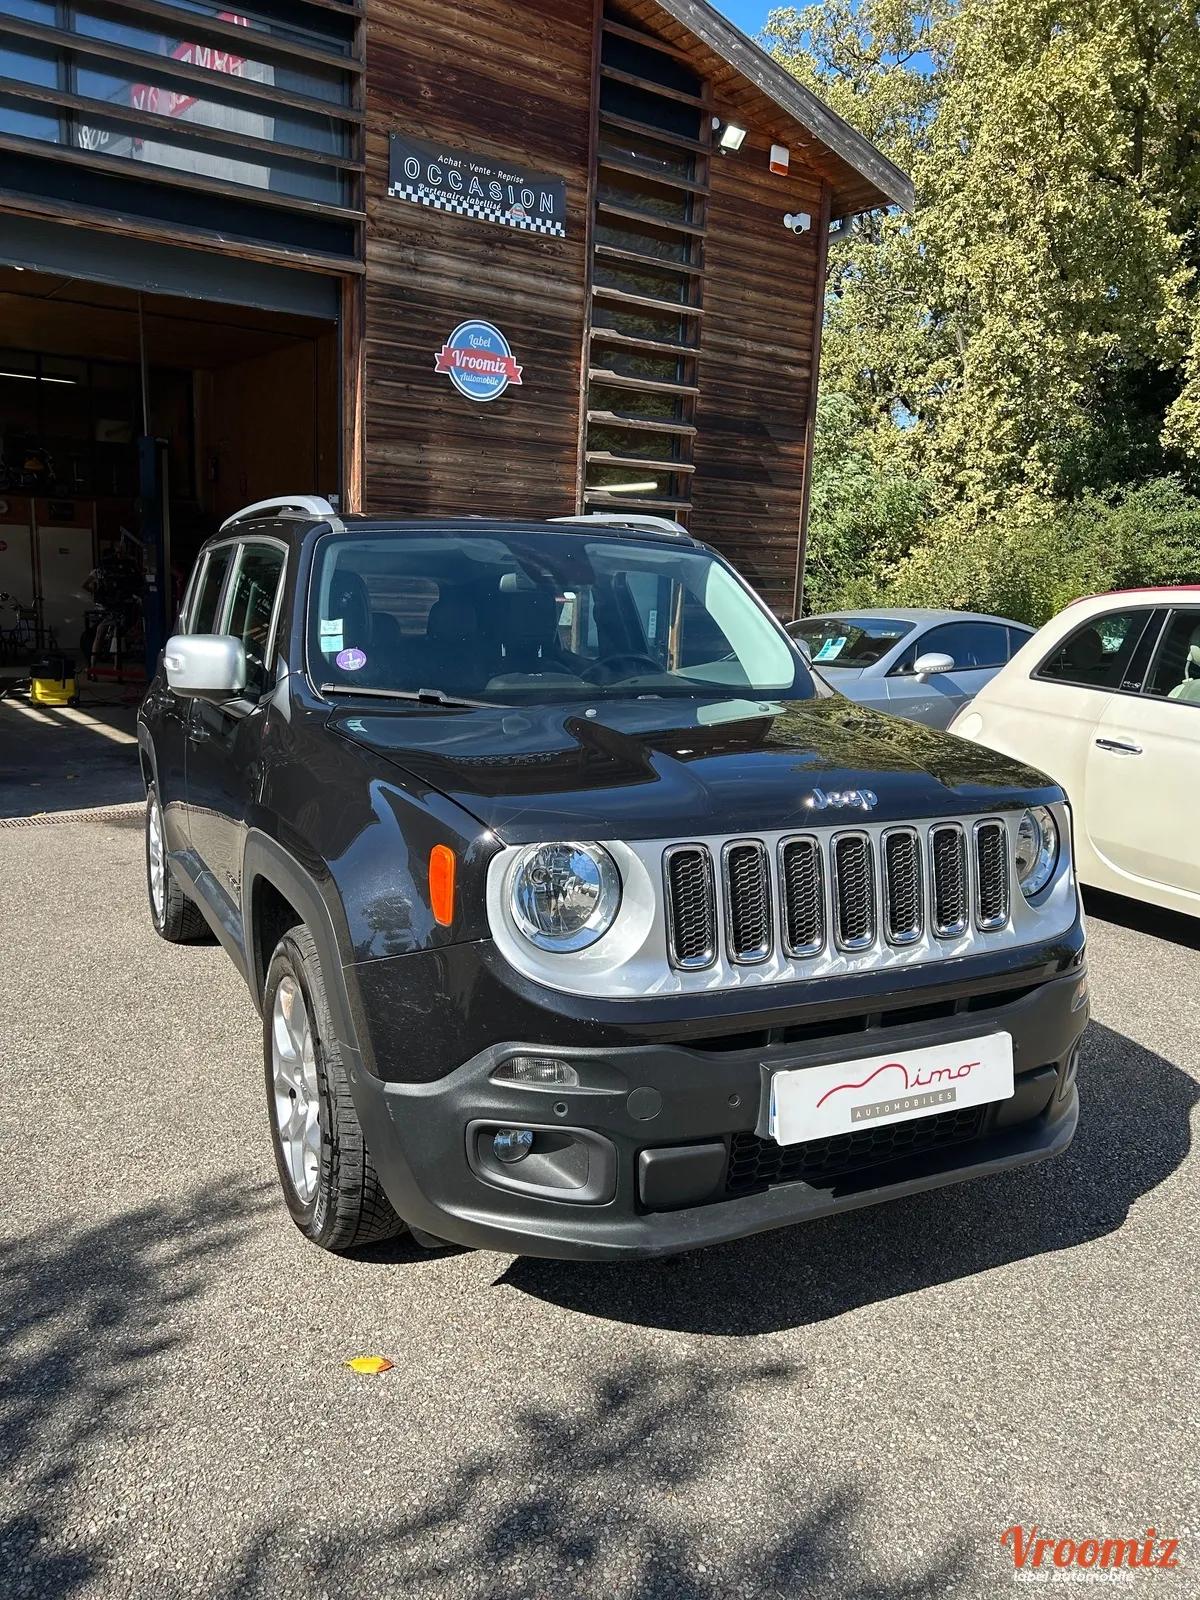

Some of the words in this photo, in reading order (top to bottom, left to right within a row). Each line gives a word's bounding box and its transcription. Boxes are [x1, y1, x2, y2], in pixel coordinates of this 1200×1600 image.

[438, 155, 461, 168] Achat
[470, 163, 491, 176] Vente
[498, 170, 524, 185] Reprise
[404, 156, 554, 214] OCCASION
[418, 183, 465, 202] Partenaire
[468, 333, 491, 349] Label
[452, 350, 506, 374] Vroomiz
[460, 372, 499, 386] Automobile
[805, 788, 878, 811] Jeep
[856, 1091, 953, 1119] AUTOMOBILES
